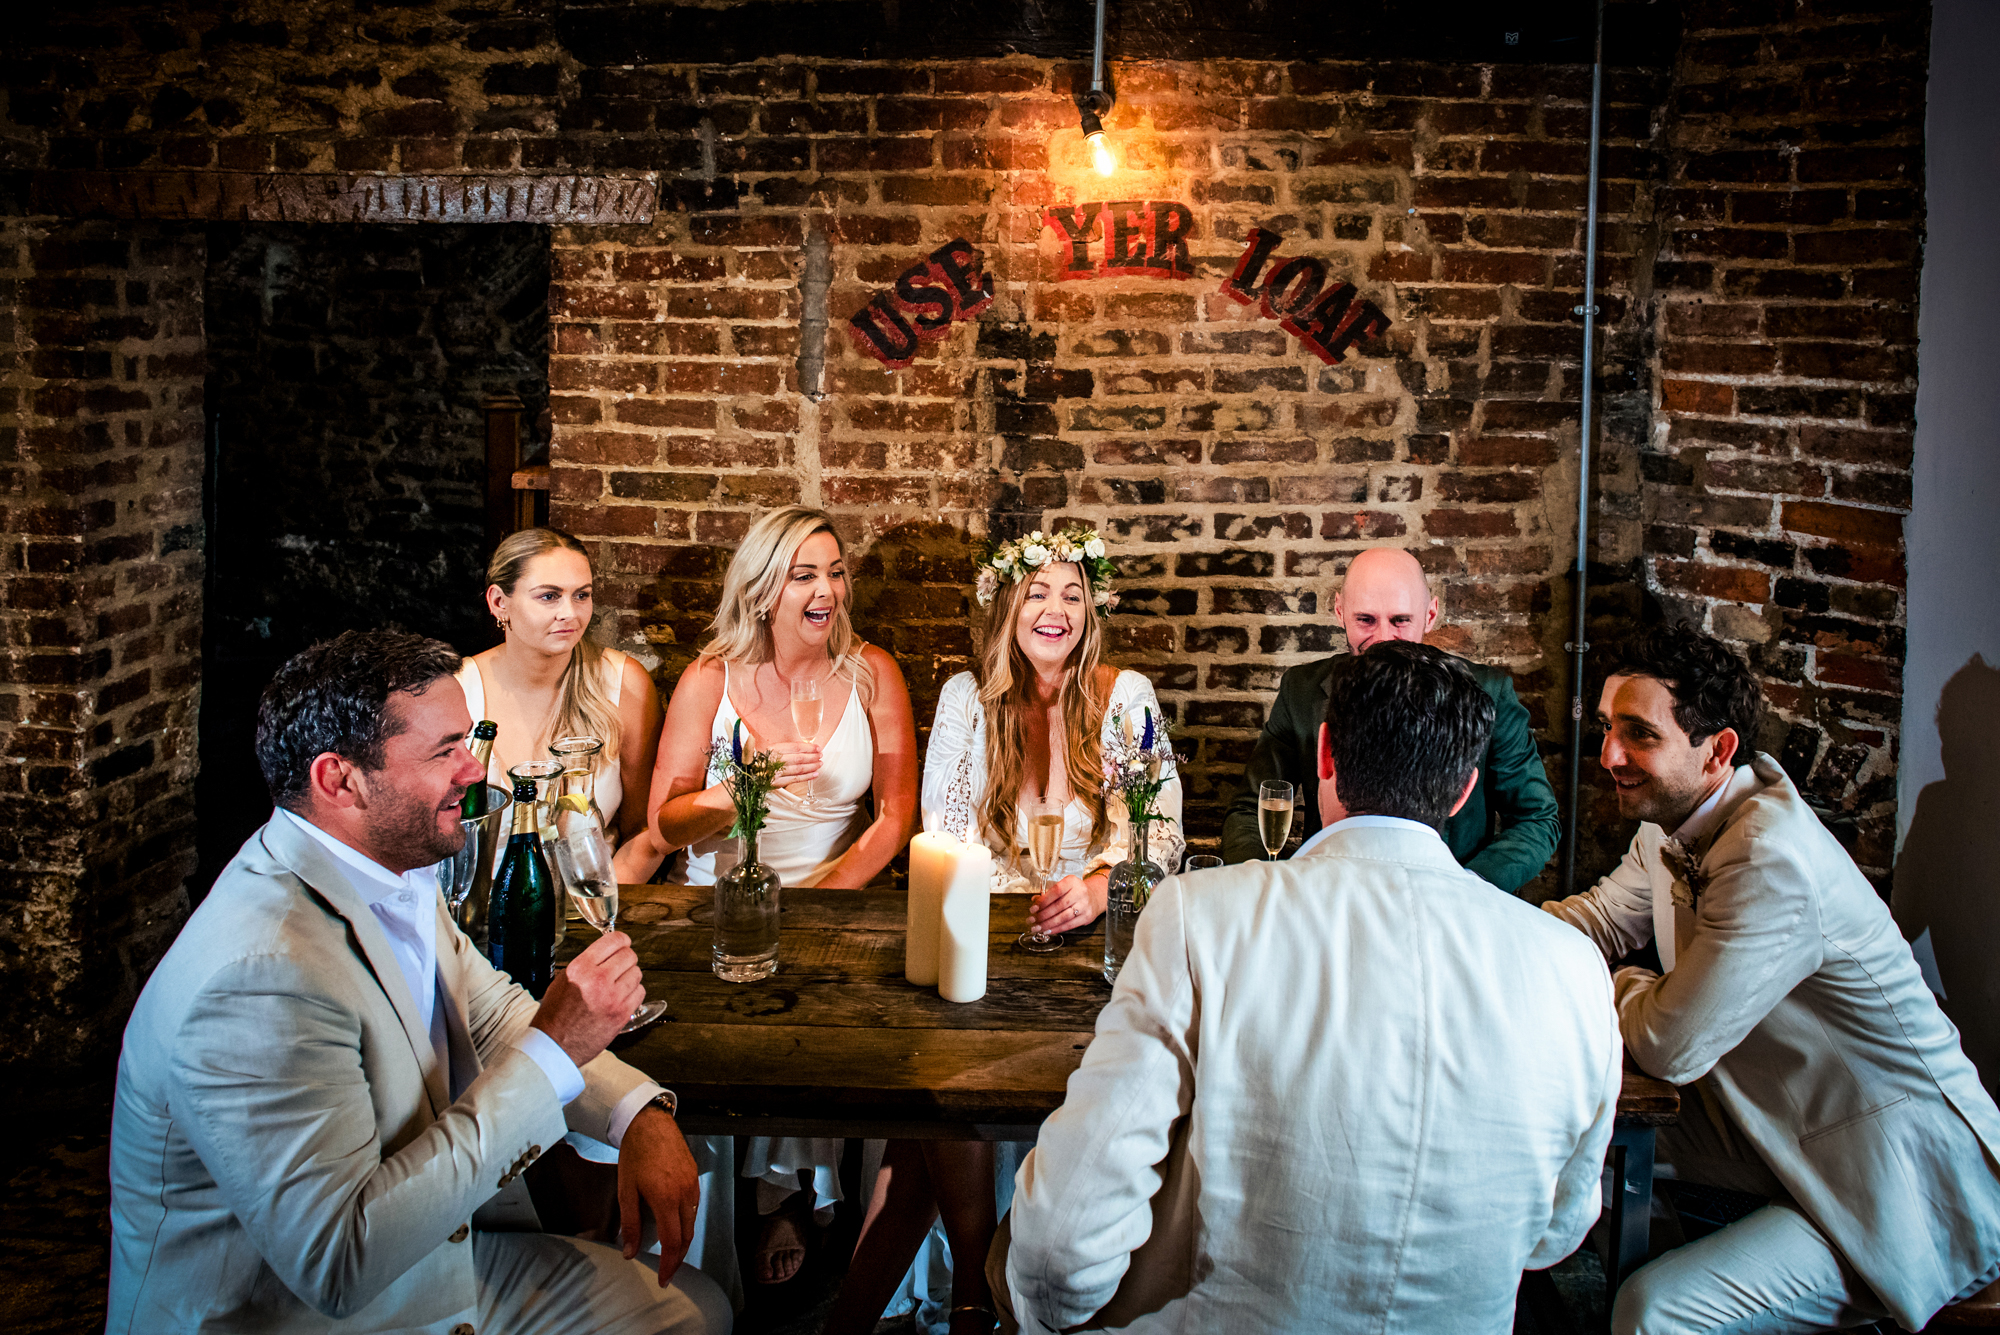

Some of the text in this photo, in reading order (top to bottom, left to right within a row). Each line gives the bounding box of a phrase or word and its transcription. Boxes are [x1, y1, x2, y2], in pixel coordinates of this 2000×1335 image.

[850, 201, 1393, 368] USE YER LOAF
